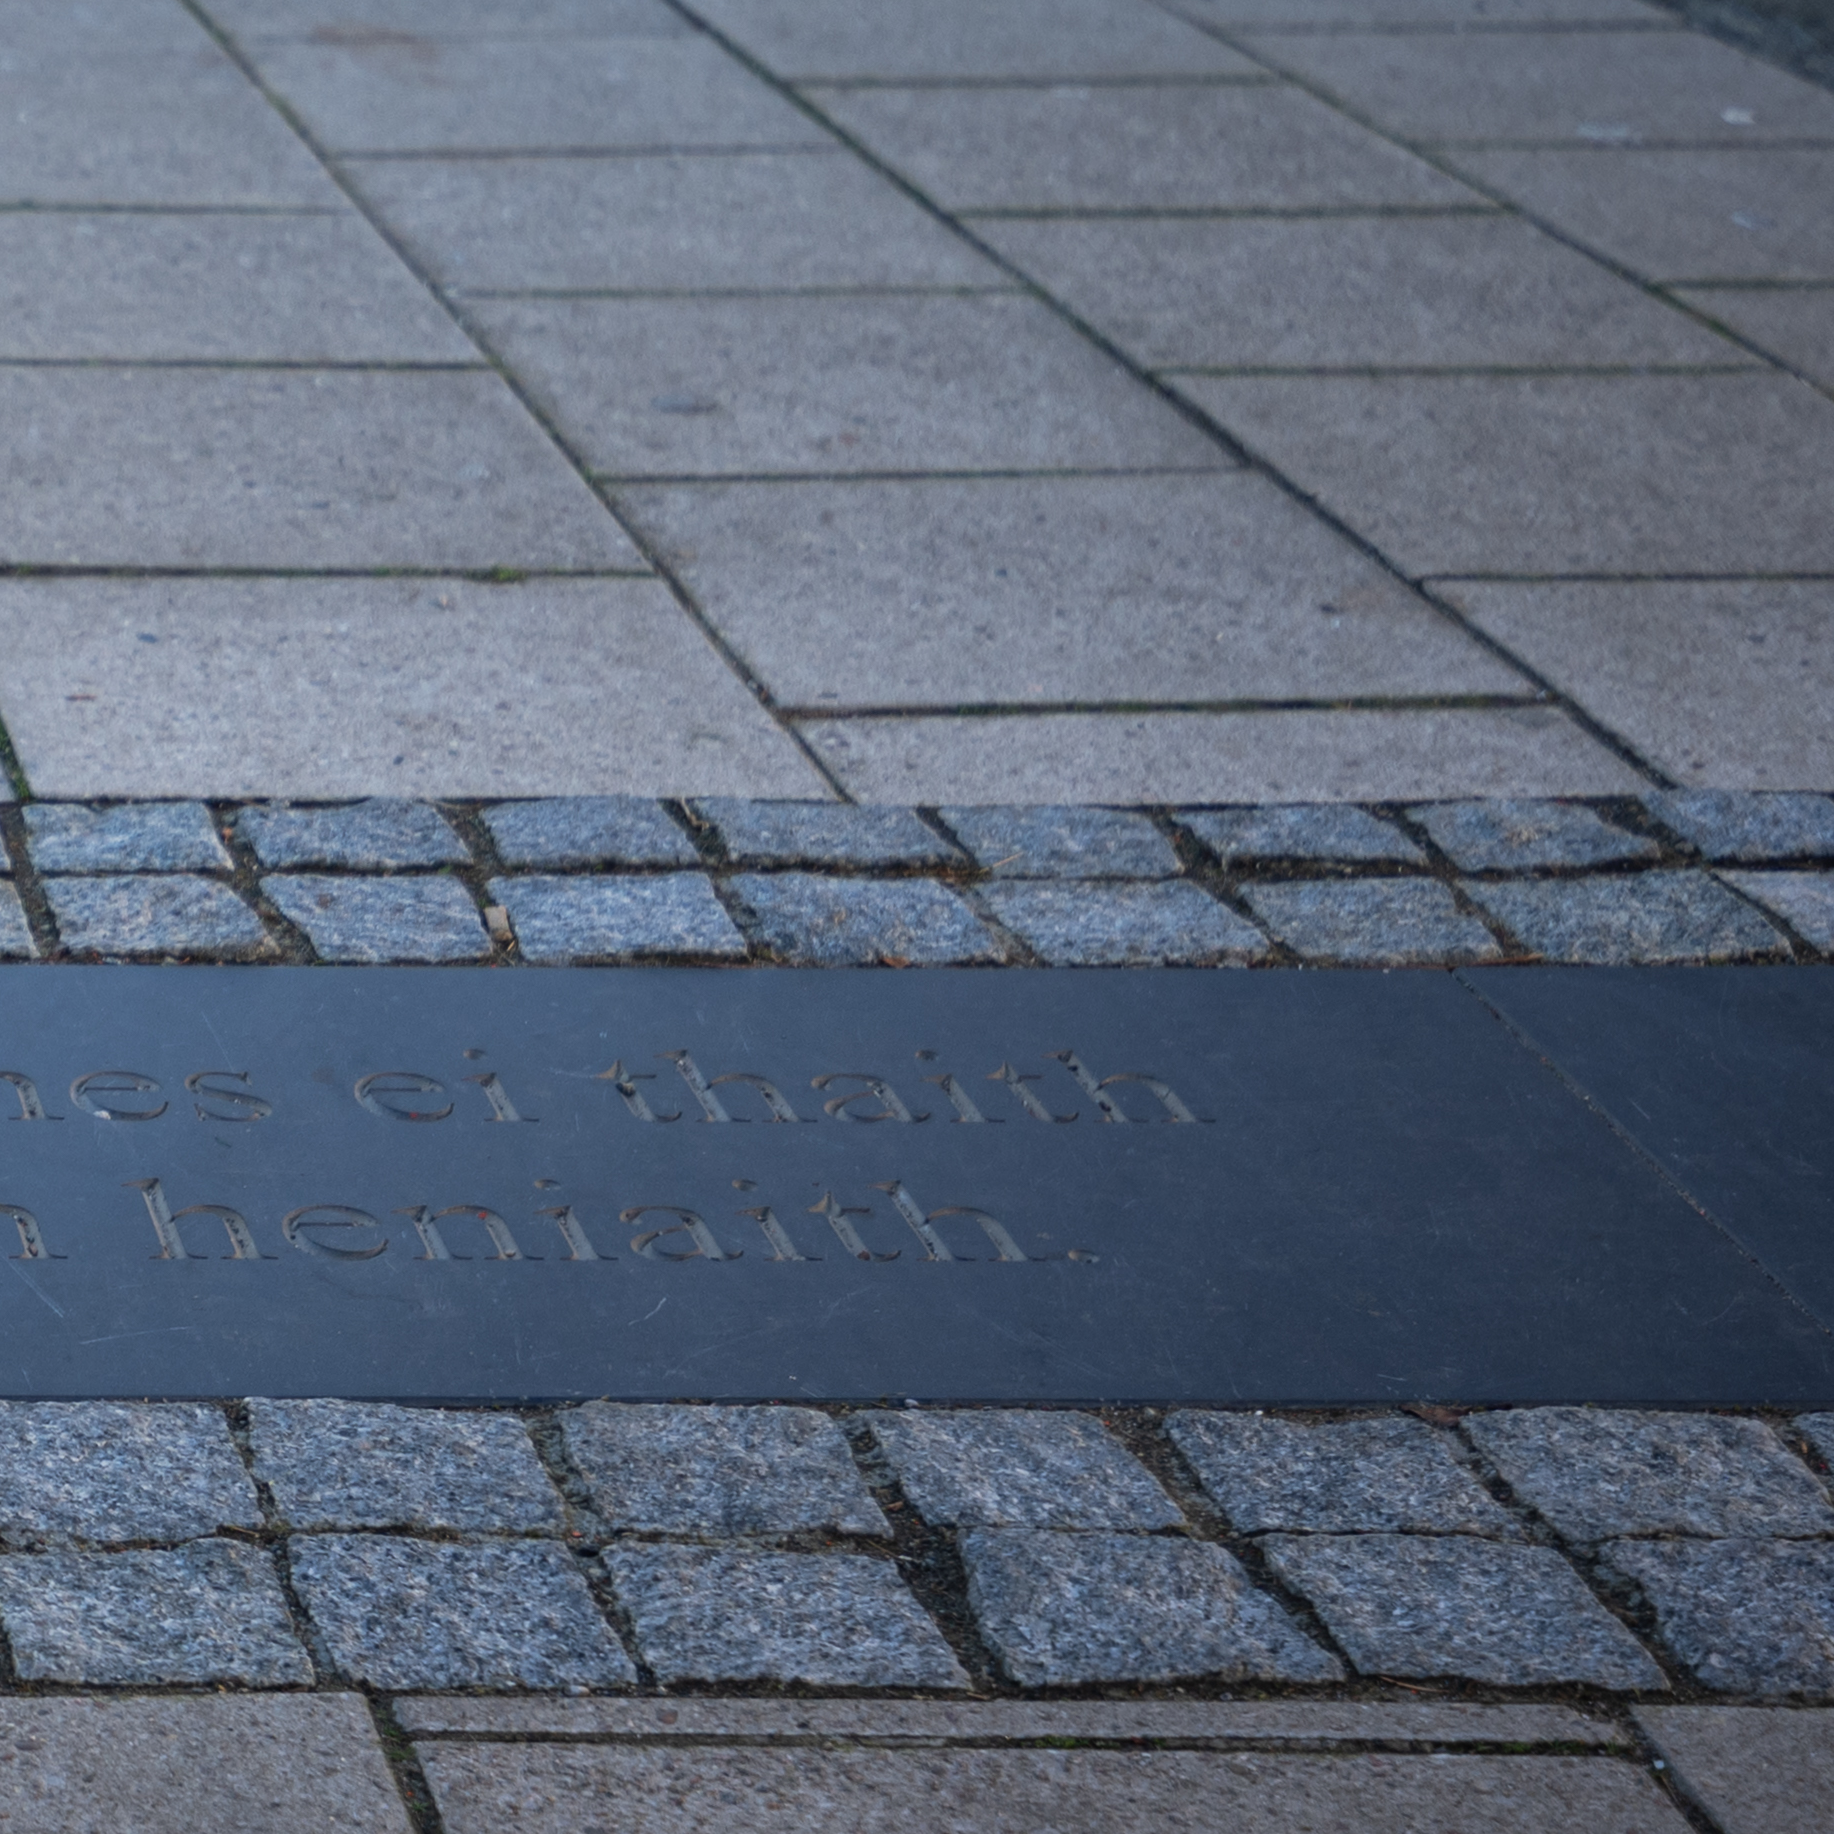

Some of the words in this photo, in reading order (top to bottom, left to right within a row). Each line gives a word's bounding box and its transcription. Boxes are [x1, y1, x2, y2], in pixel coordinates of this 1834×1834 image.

[354, 1048, 540, 1124] ei
[599, 1049, 1216, 1124] thaith
[122, 1178, 1100, 1265] heniaith.
